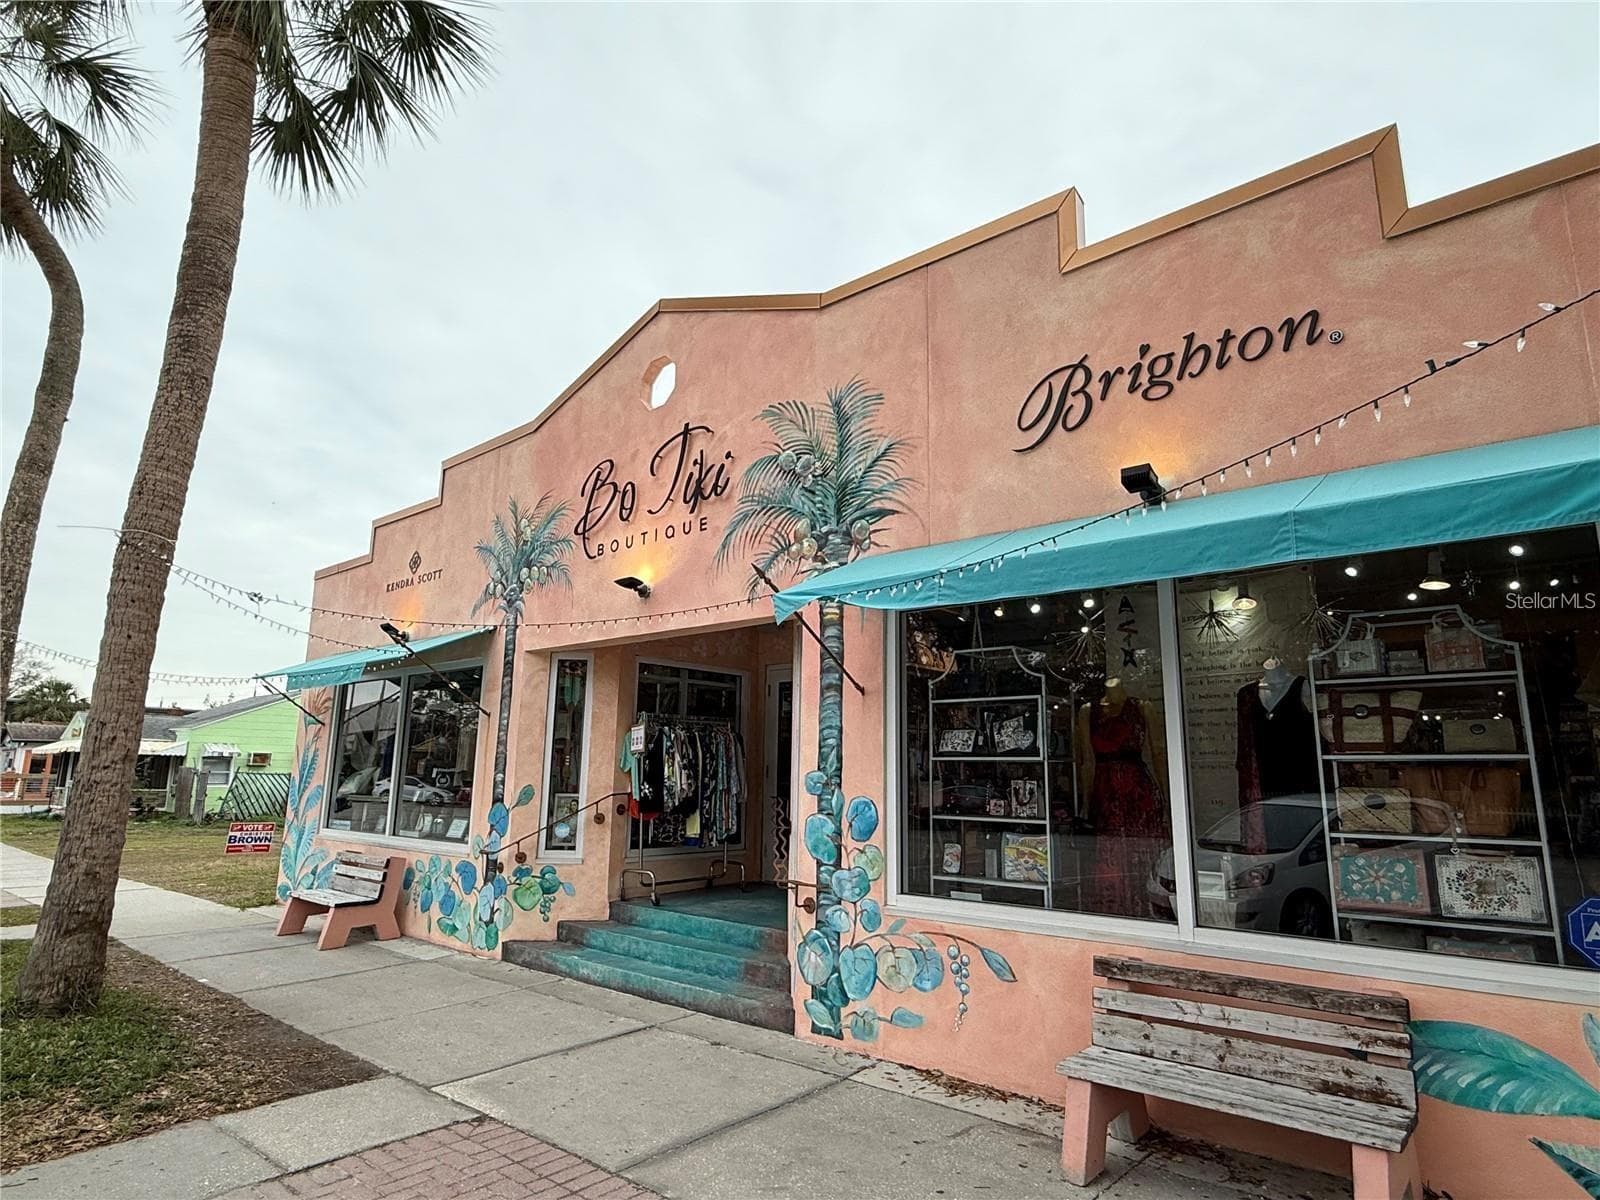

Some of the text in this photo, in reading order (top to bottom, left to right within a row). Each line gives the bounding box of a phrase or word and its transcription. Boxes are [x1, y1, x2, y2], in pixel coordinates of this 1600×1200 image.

[574, 422, 735, 560] Bo Tiki
[597, 517, 708, 557] BOUTIQUE
[385, 568, 444, 593] KENDRA SCOTT
[228, 835, 272, 844] BROWN
